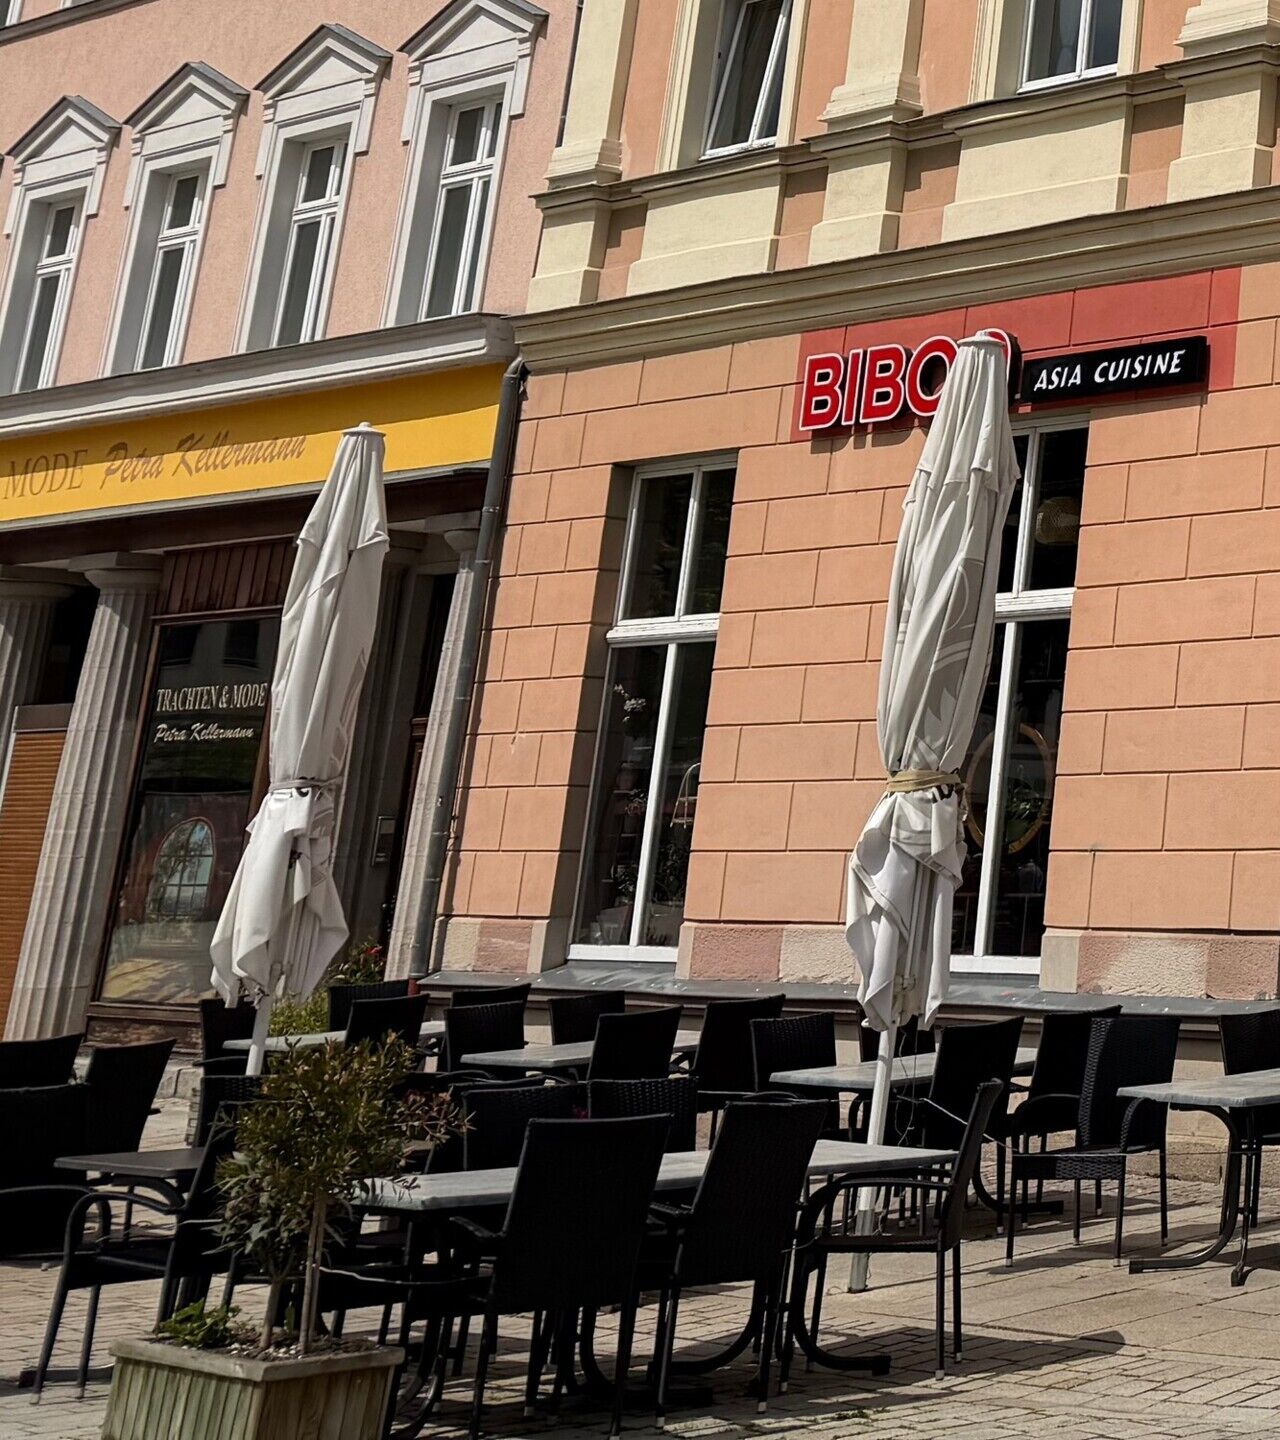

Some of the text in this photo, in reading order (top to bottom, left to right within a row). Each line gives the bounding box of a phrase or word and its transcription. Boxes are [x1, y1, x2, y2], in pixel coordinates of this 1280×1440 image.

[800, 327, 1012, 431] BIBO
[1033, 348, 1186, 392] ASIA CUISINE
[3, 429, 308, 500] MODE Petra Kellermann
[156, 683, 268, 712] TRACHTEN & MODE
[153, 722, 255, 743] Petra Kellermann
